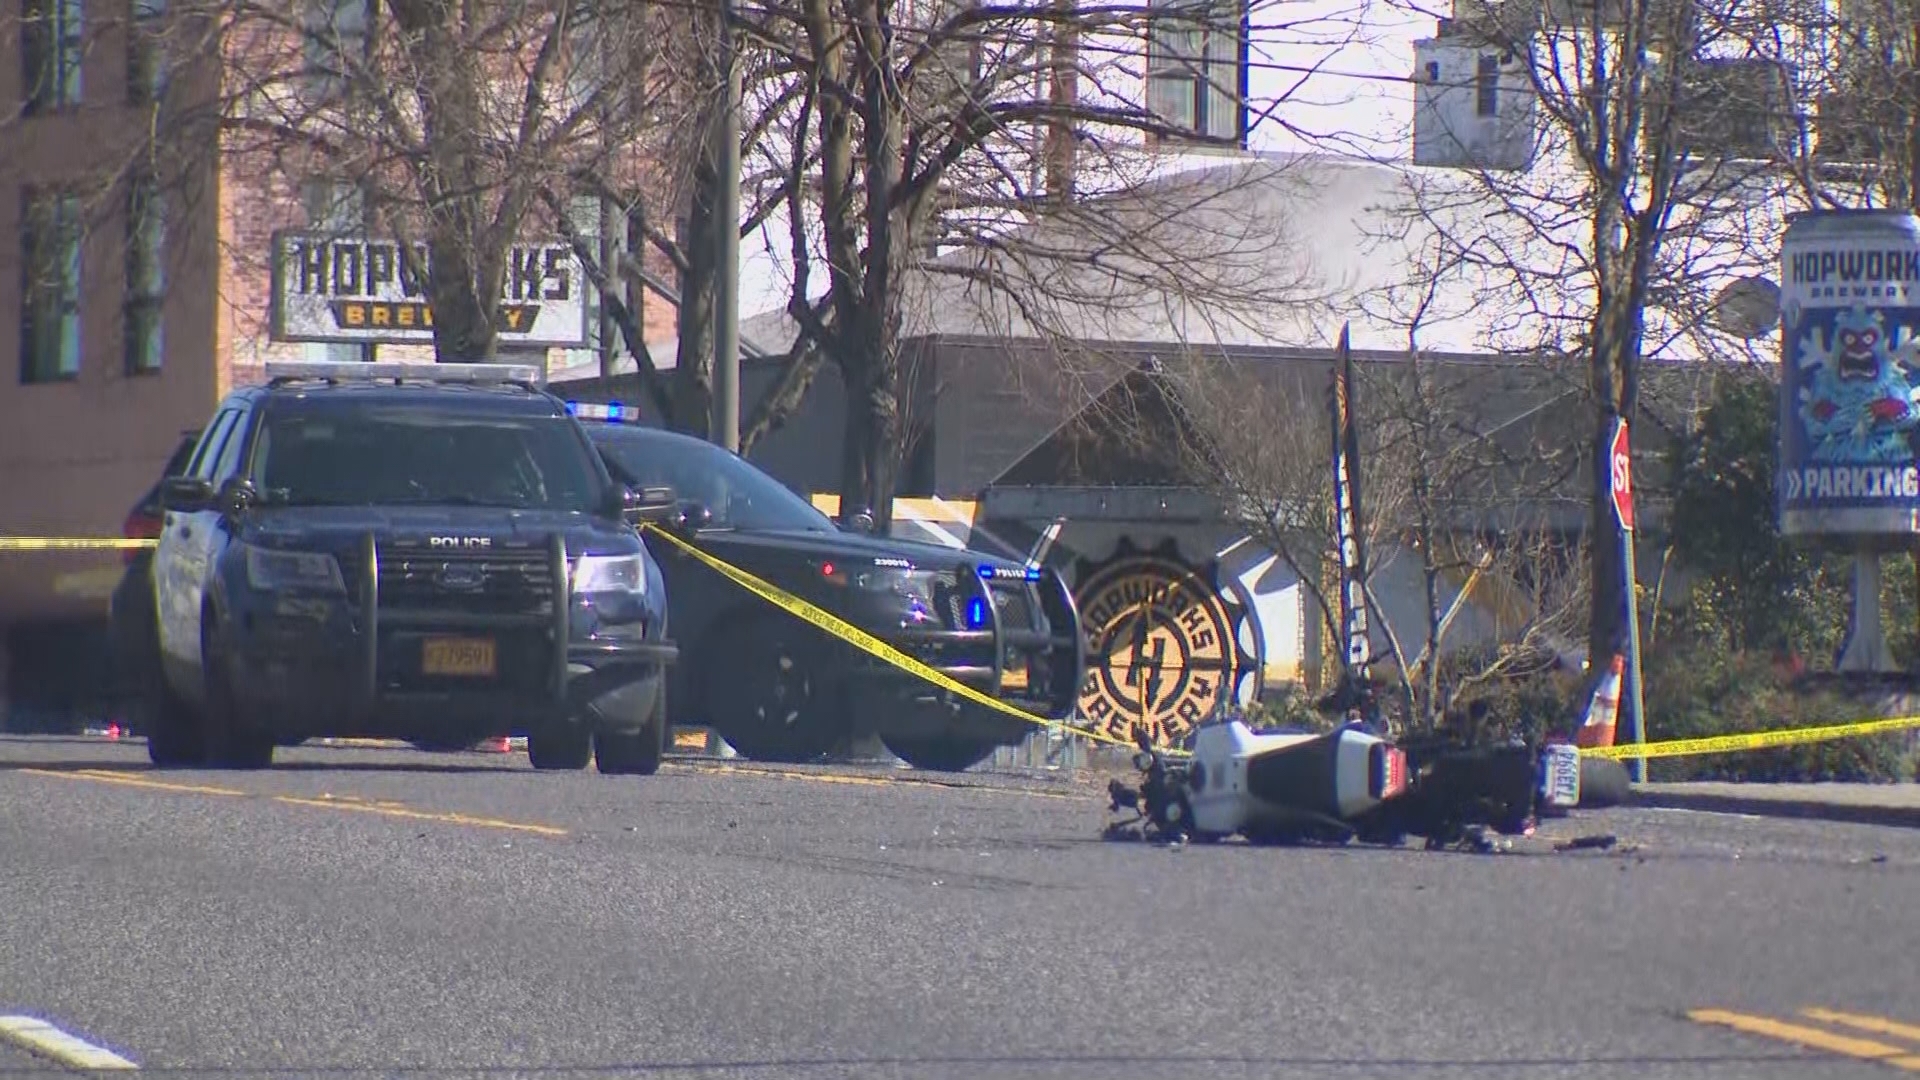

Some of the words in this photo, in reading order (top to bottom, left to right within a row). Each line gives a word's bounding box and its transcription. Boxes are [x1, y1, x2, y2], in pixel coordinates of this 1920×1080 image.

[299, 242, 571, 301] HOPWKS
[1811, 286, 1909, 298] BREWERY
[345, 304, 524, 329] BREY
[1804, 467, 1919, 498] PARKING
[430, 537, 492, 549] POLICE
